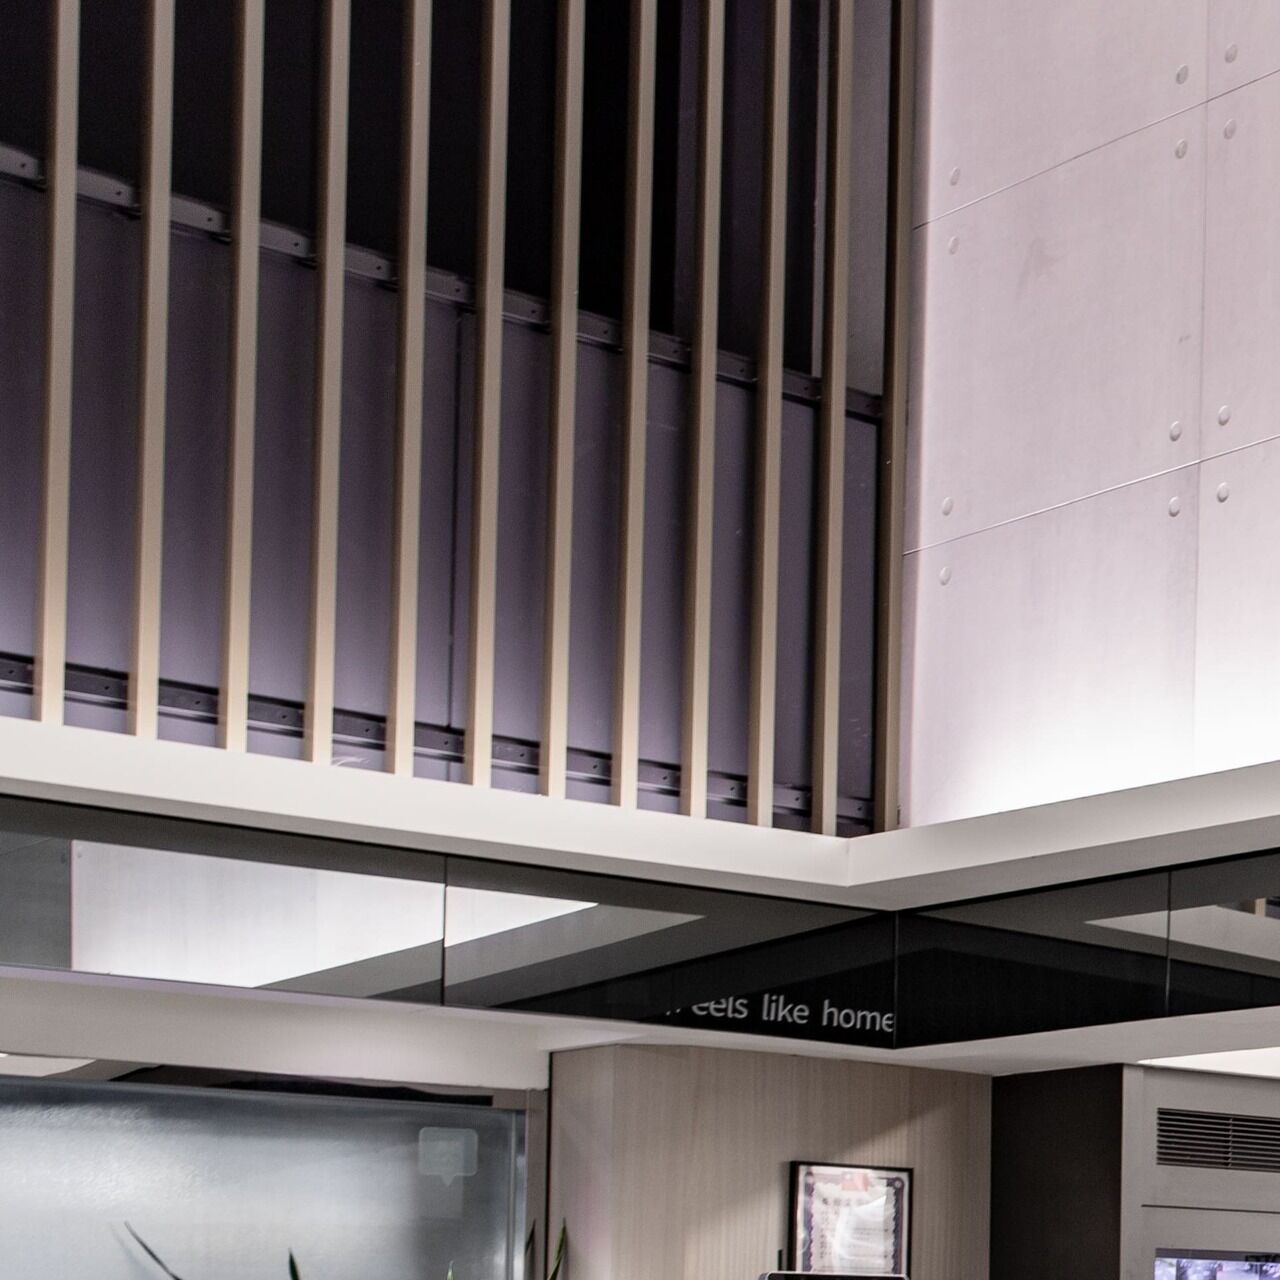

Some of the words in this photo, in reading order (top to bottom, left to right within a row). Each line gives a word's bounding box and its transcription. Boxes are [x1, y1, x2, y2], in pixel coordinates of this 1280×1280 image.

[676, 997, 749, 1019] eels
[762, 993, 810, 1024] like
[822, 999, 894, 1033] home
